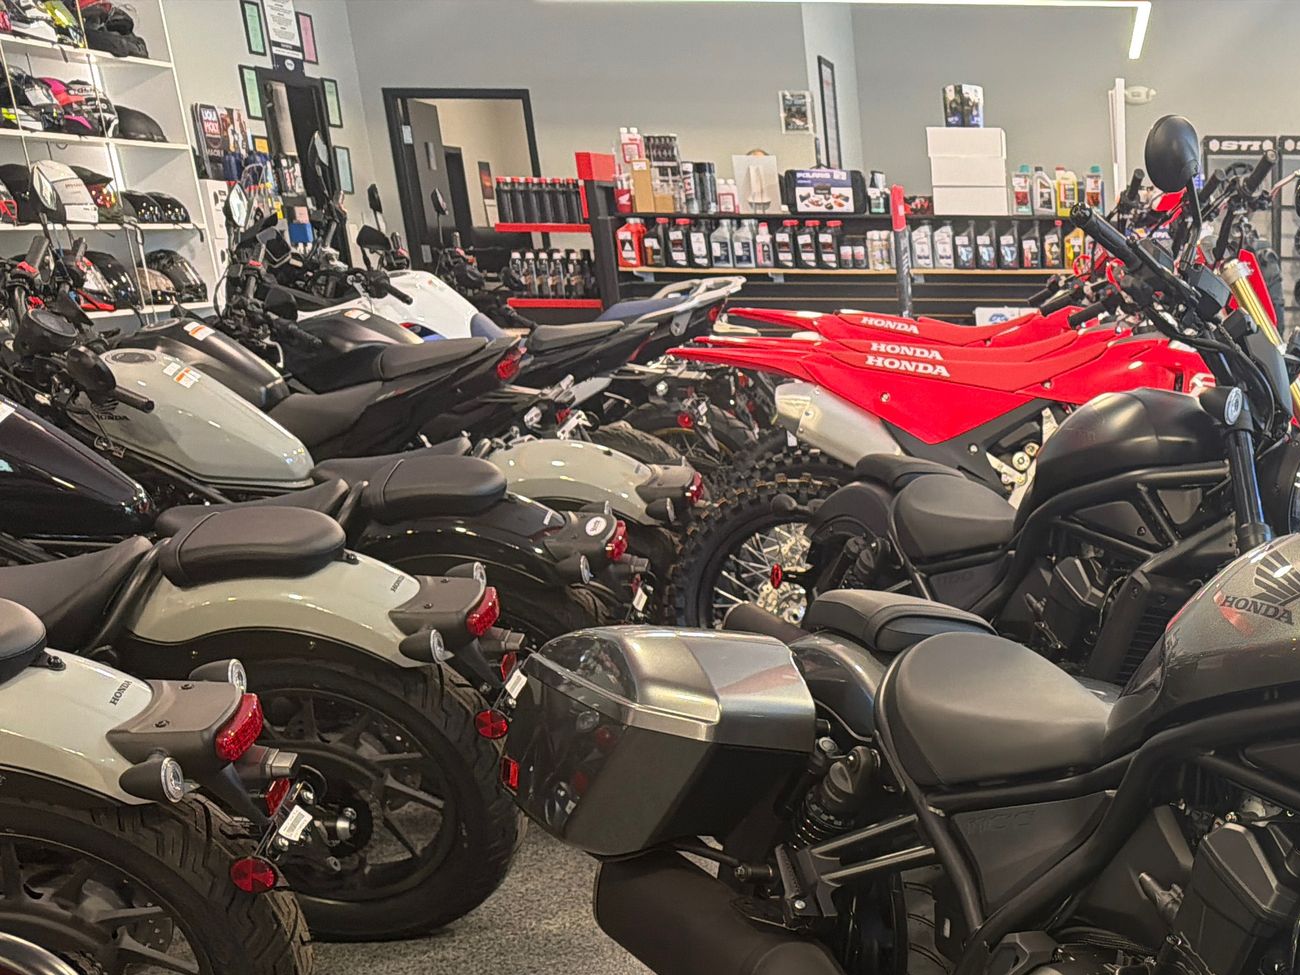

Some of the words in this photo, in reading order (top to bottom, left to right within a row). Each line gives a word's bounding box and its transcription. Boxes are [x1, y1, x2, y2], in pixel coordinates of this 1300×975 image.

[1220, 140, 1262, 151] STI
[861, 316, 920, 335] HONDA
[870, 342, 945, 361] HONDA
[865, 355, 951, 378] HONDA
[1220, 595, 1295, 626] HONDA
[109, 679, 132, 706] HONDA
